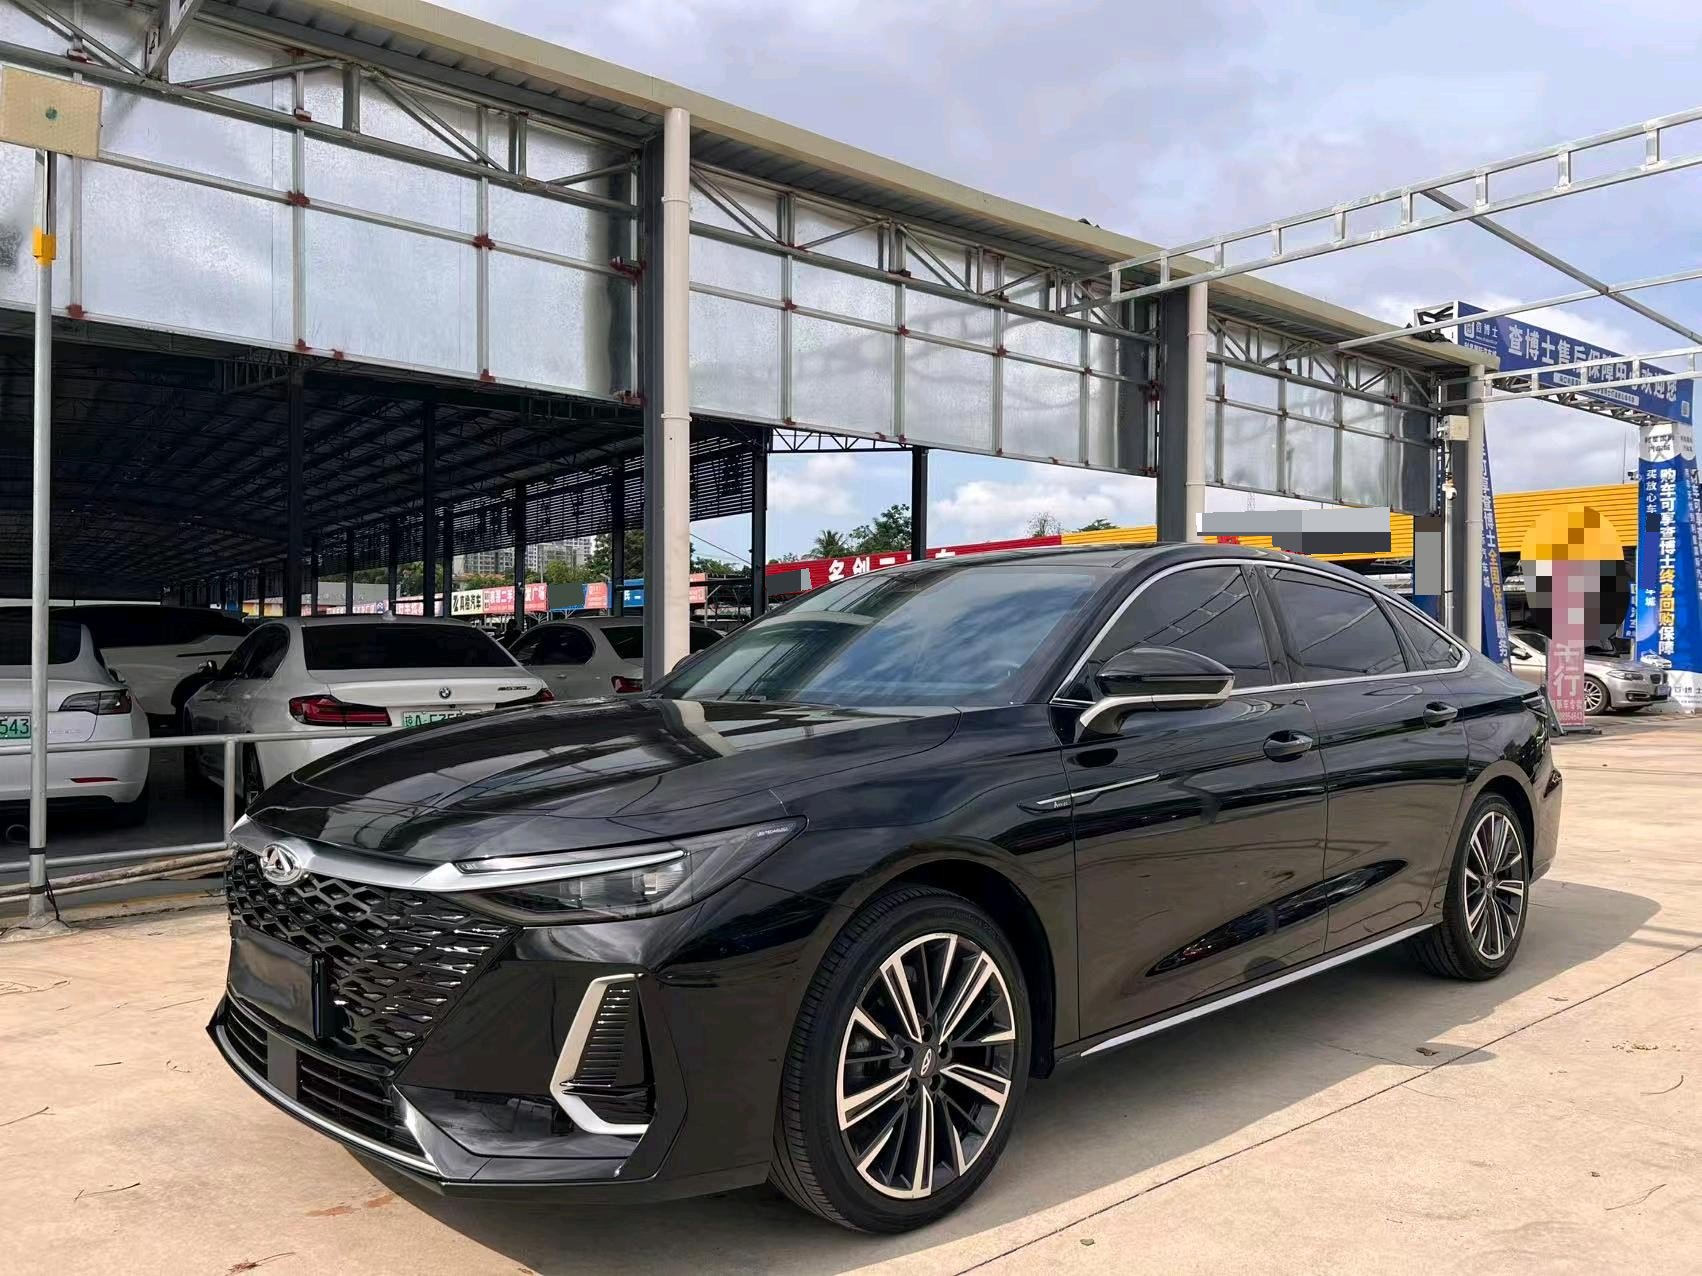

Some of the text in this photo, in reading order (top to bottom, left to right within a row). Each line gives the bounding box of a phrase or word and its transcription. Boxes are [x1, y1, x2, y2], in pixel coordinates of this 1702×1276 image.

[1646, 469, 1657, 514] 买放心车
[1659, 468, 1677, 655] 购车可享查博士终身回购保障
